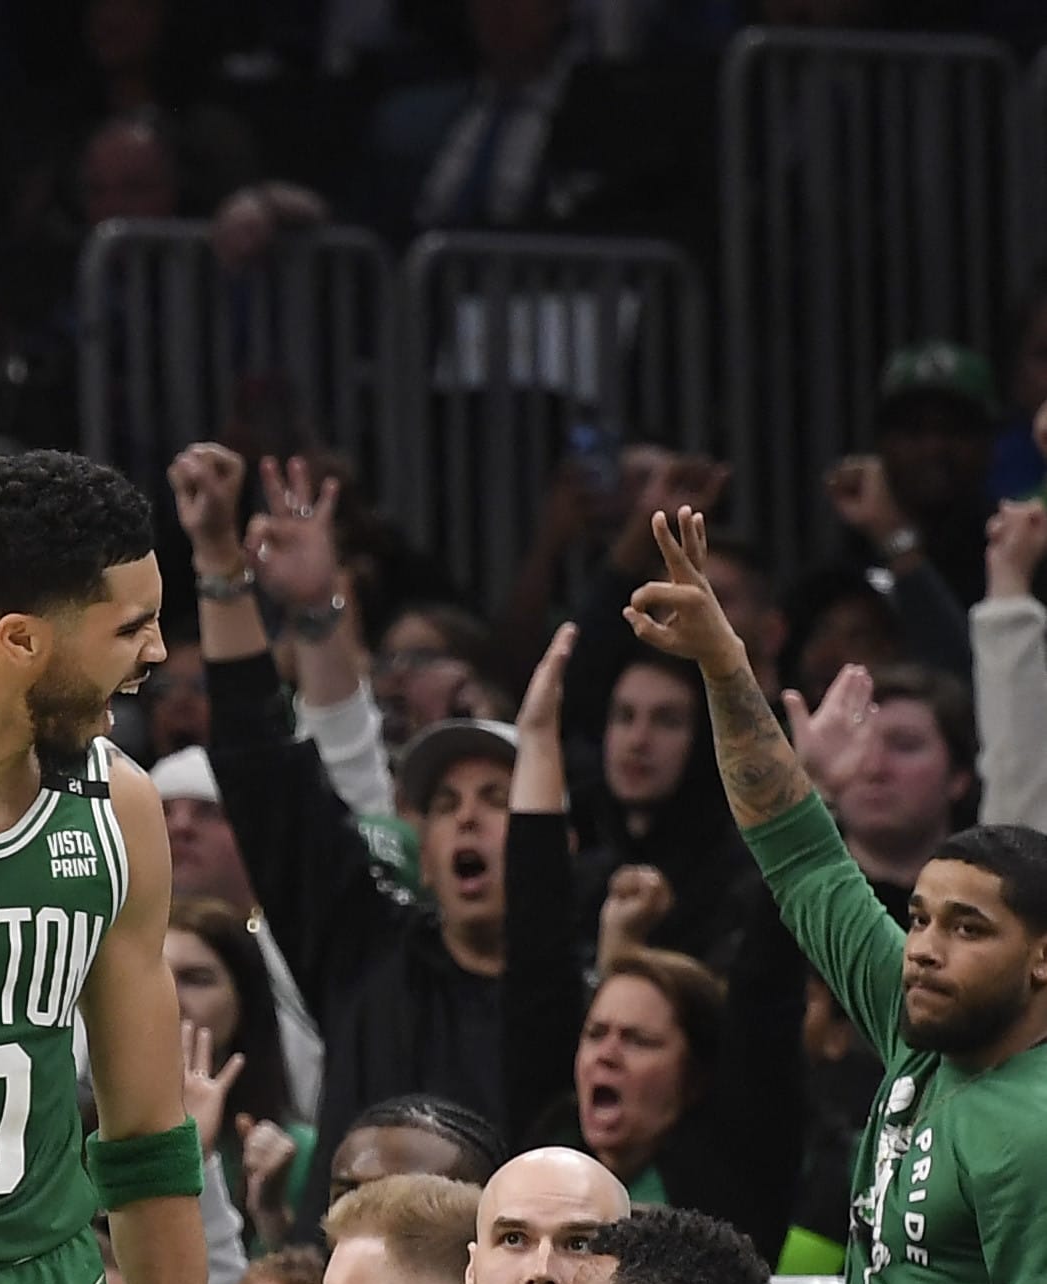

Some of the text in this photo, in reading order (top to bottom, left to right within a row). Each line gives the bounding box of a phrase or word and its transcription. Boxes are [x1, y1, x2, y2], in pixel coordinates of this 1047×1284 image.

[67, 778, 83, 795] 24
[46, 830, 97, 858] VISTA
[50, 857, 98, 878] PRINT
[904, 1127, 933, 1267] PRIDE
